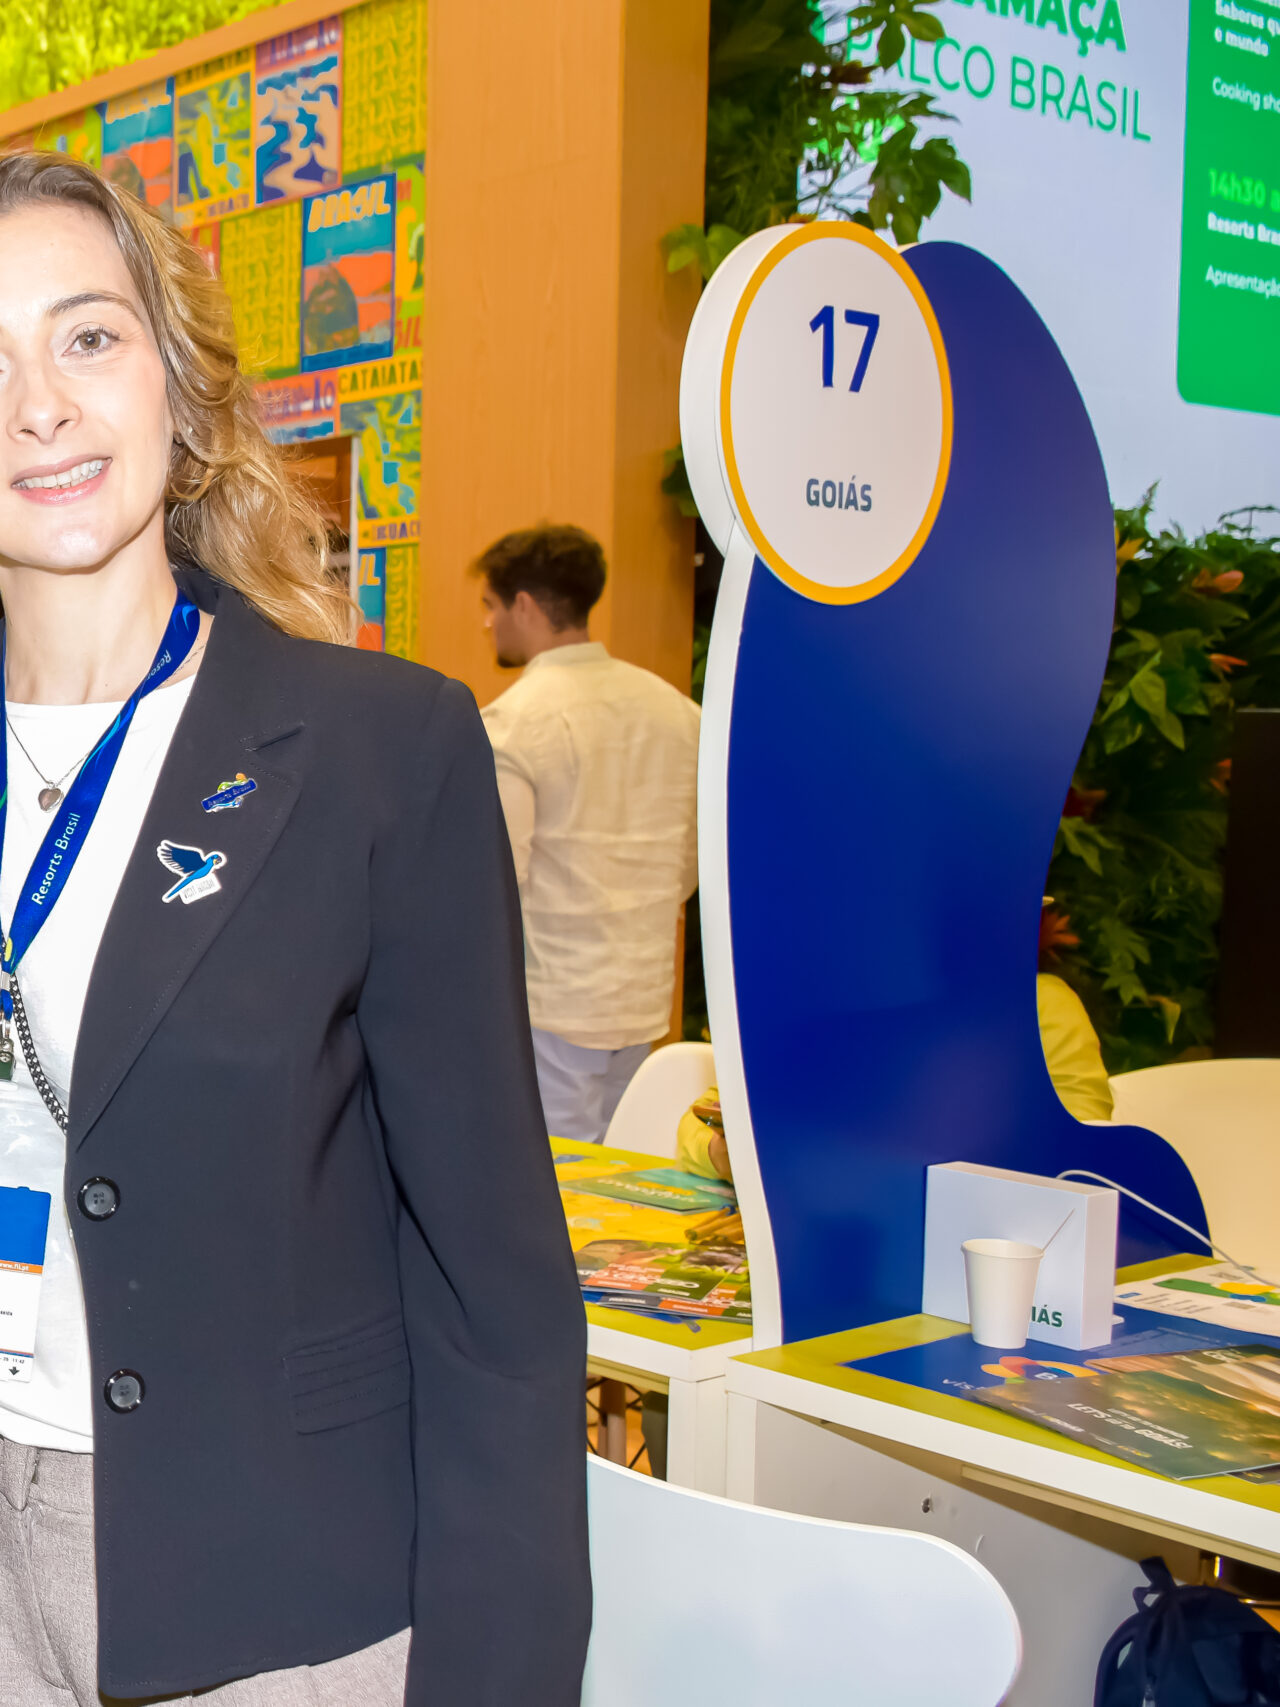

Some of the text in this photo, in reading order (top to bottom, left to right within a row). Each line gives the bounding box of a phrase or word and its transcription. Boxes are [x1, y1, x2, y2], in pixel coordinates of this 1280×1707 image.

[846, 13, 1152, 142] PLCO BRASIL
[1212, 76, 1261, 111] Cooking
[1209, 167, 1266, 208] 14h30
[1207, 211, 1255, 240] Resorts
[808, 304, 880, 393] 17
[805, 475, 872, 512] GOIÁS
[31, 812, 81, 905] Resorts Brasil
[1031, 1304, 1063, 1328] IÁS
